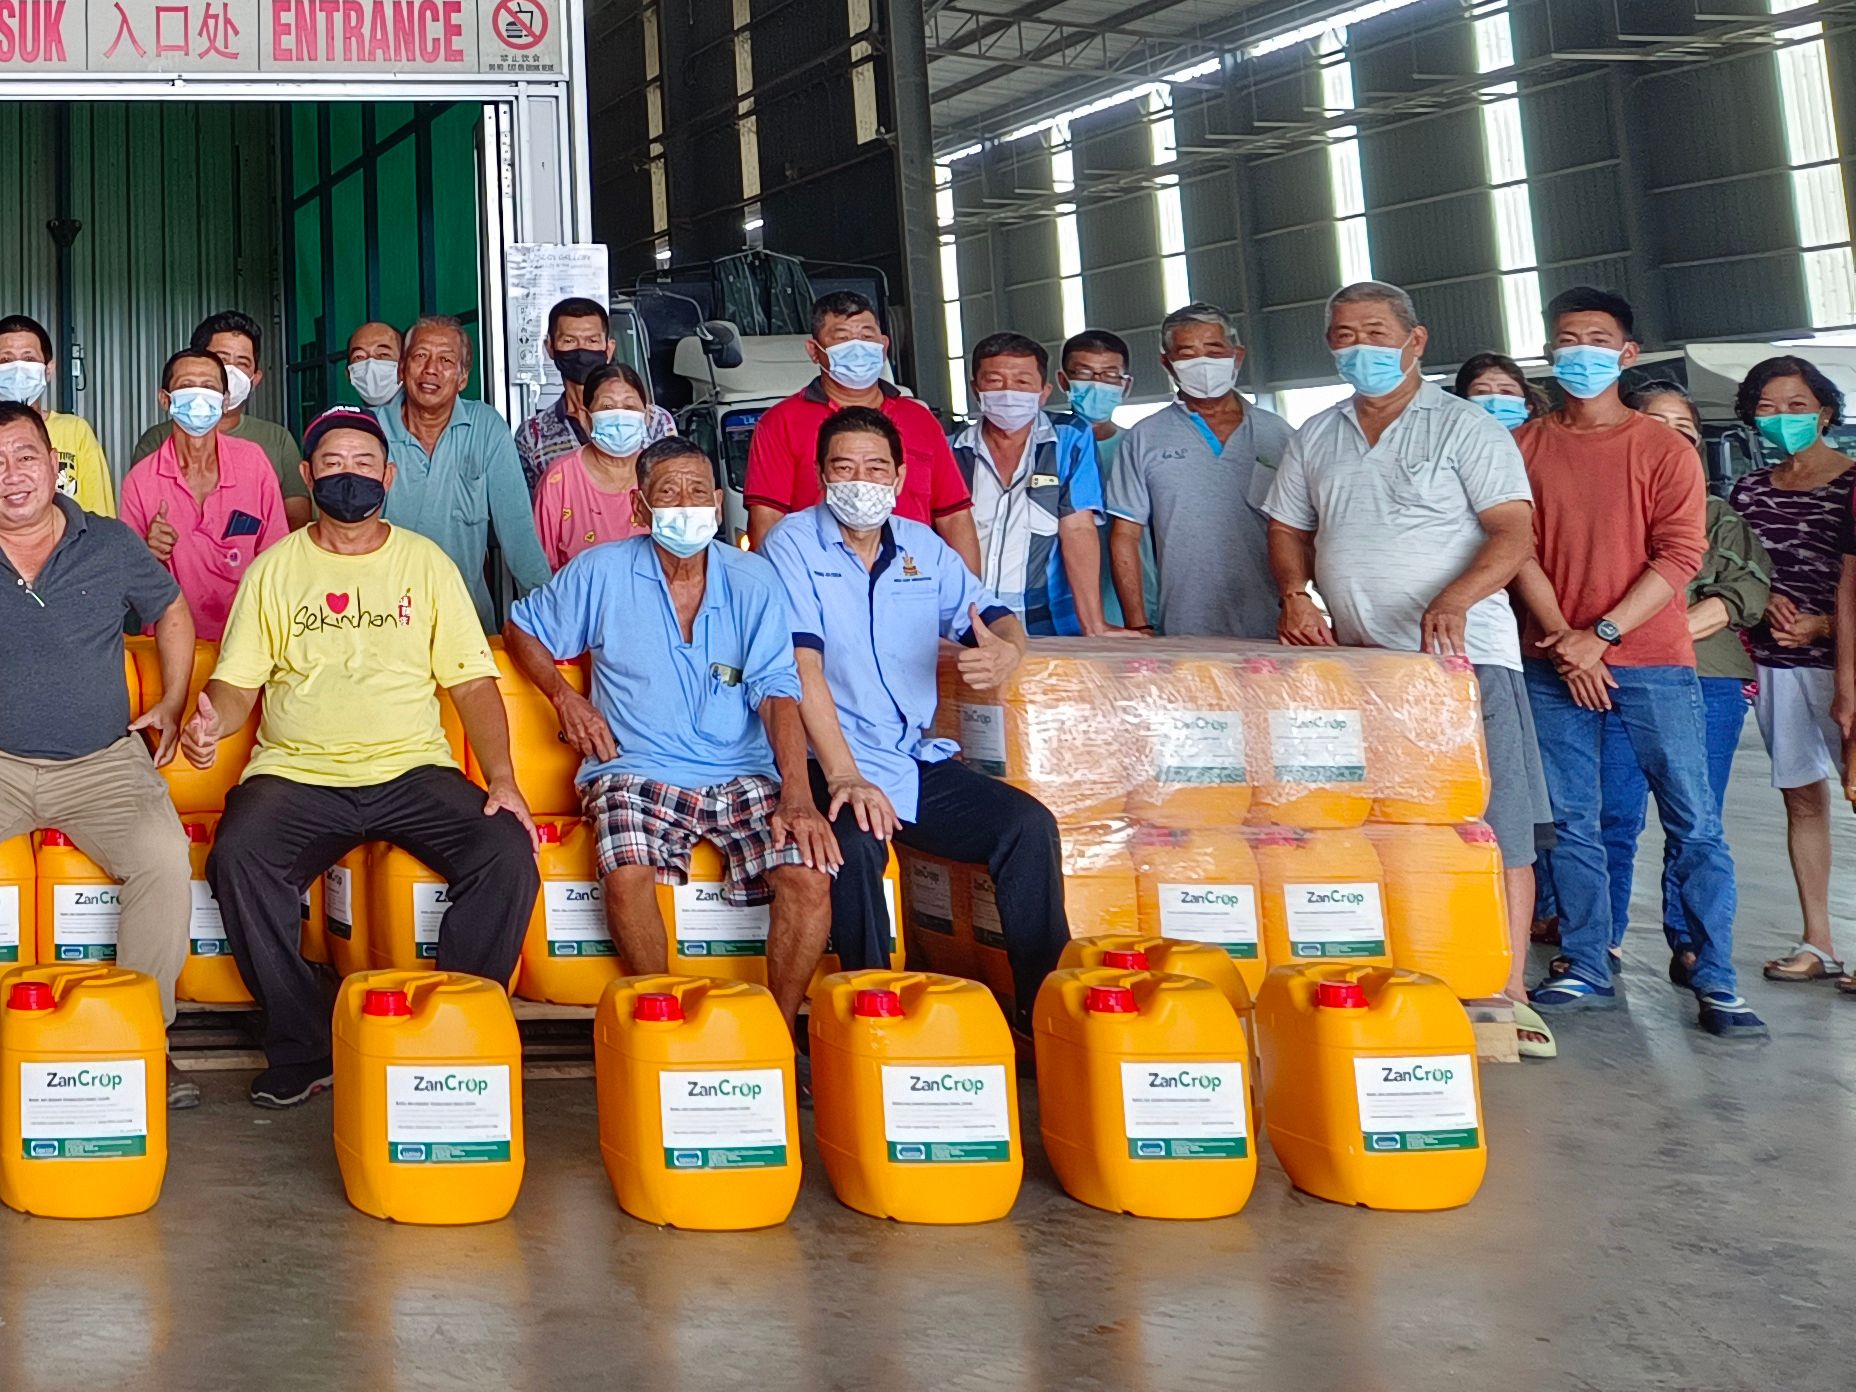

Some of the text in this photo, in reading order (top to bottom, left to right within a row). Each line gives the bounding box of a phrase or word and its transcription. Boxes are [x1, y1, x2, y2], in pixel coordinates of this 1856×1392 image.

[104, 1, 241, 60] 入口处
[271, 0, 465, 64] ENTRANCE
[293, 586, 398, 637] Sekinchan
[1181, 891, 1239, 907] ZanCrop
[1306, 890, 1364, 906] ZanCrop
[46, 1069, 123, 1090] ZanCrop
[413, 1074, 488, 1096] ZanCrop
[910, 1074, 984, 1095] ZanCrop
[1148, 1070, 1222, 1092] ZanCrop
[1381, 1063, 1454, 1086] ZanCrop
[687, 1079, 762, 1100] ZanCrop
